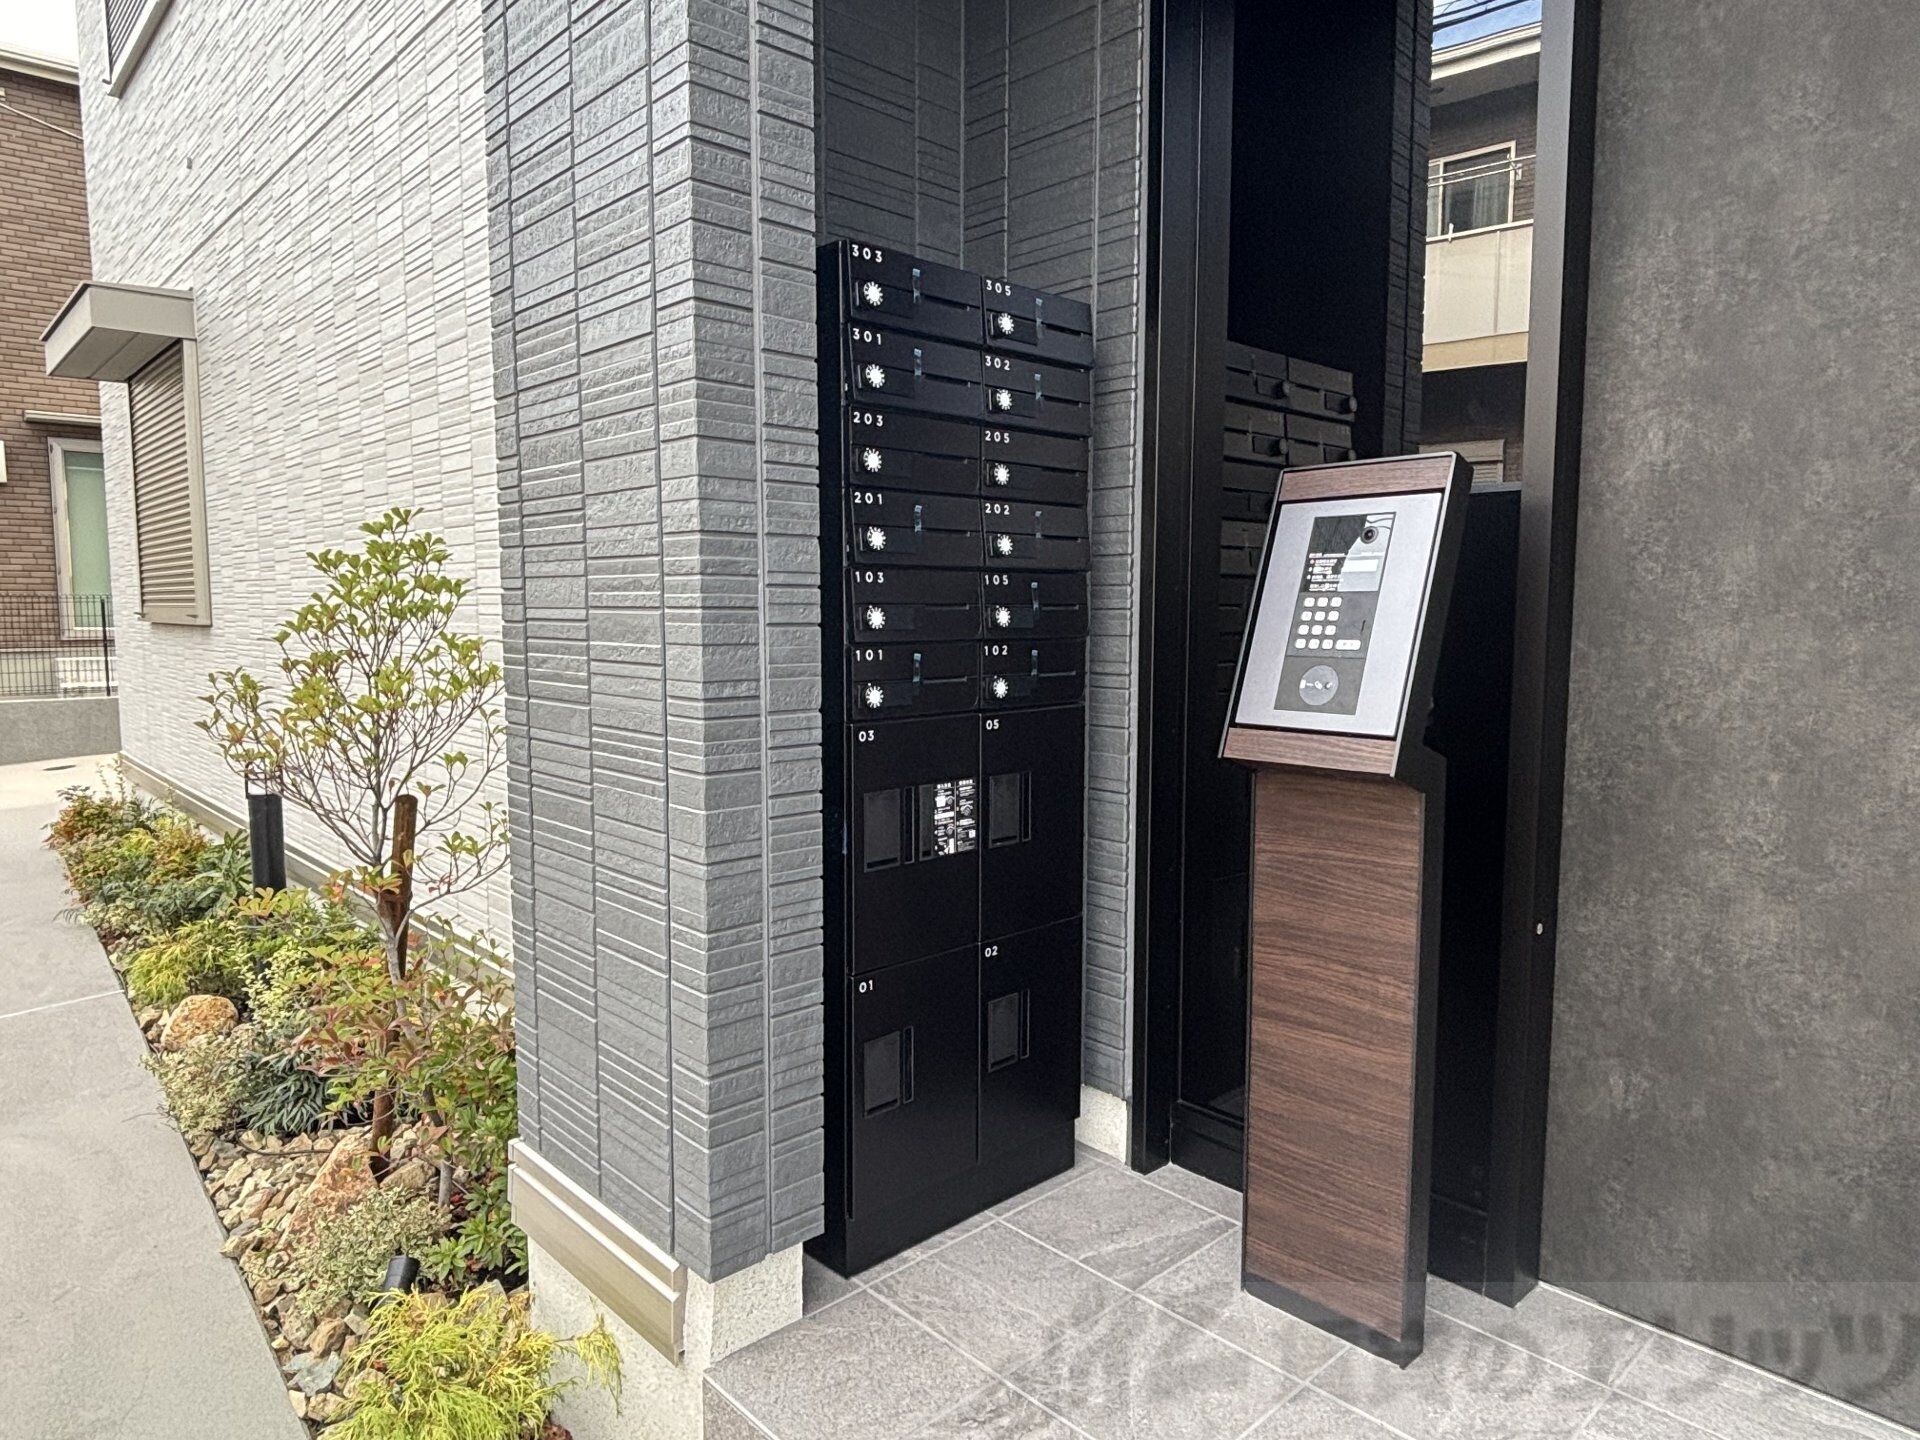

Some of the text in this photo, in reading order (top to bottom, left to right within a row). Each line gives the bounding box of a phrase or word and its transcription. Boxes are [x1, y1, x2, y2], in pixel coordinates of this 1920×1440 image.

[851, 244, 883, 263] 303
[986, 280, 1012, 296] 305
[852, 328, 882, 345] 301
[985, 356, 1010, 371] 302
[853, 411, 884, 427] 203
[984, 430, 1010, 444] 205
[853, 491, 883, 505] 201
[984, 502, 1011, 516] 202
[854, 570, 885, 584] 103
[984, 574, 1009, 586] 105
[855, 649, 883, 662] 101
[983, 644, 1008, 656] 102
[985, 718, 1000, 730] 05
[858, 729, 875, 743] 03
[984, 945, 998, 958] 02
[858, 979, 873, 994] 01
